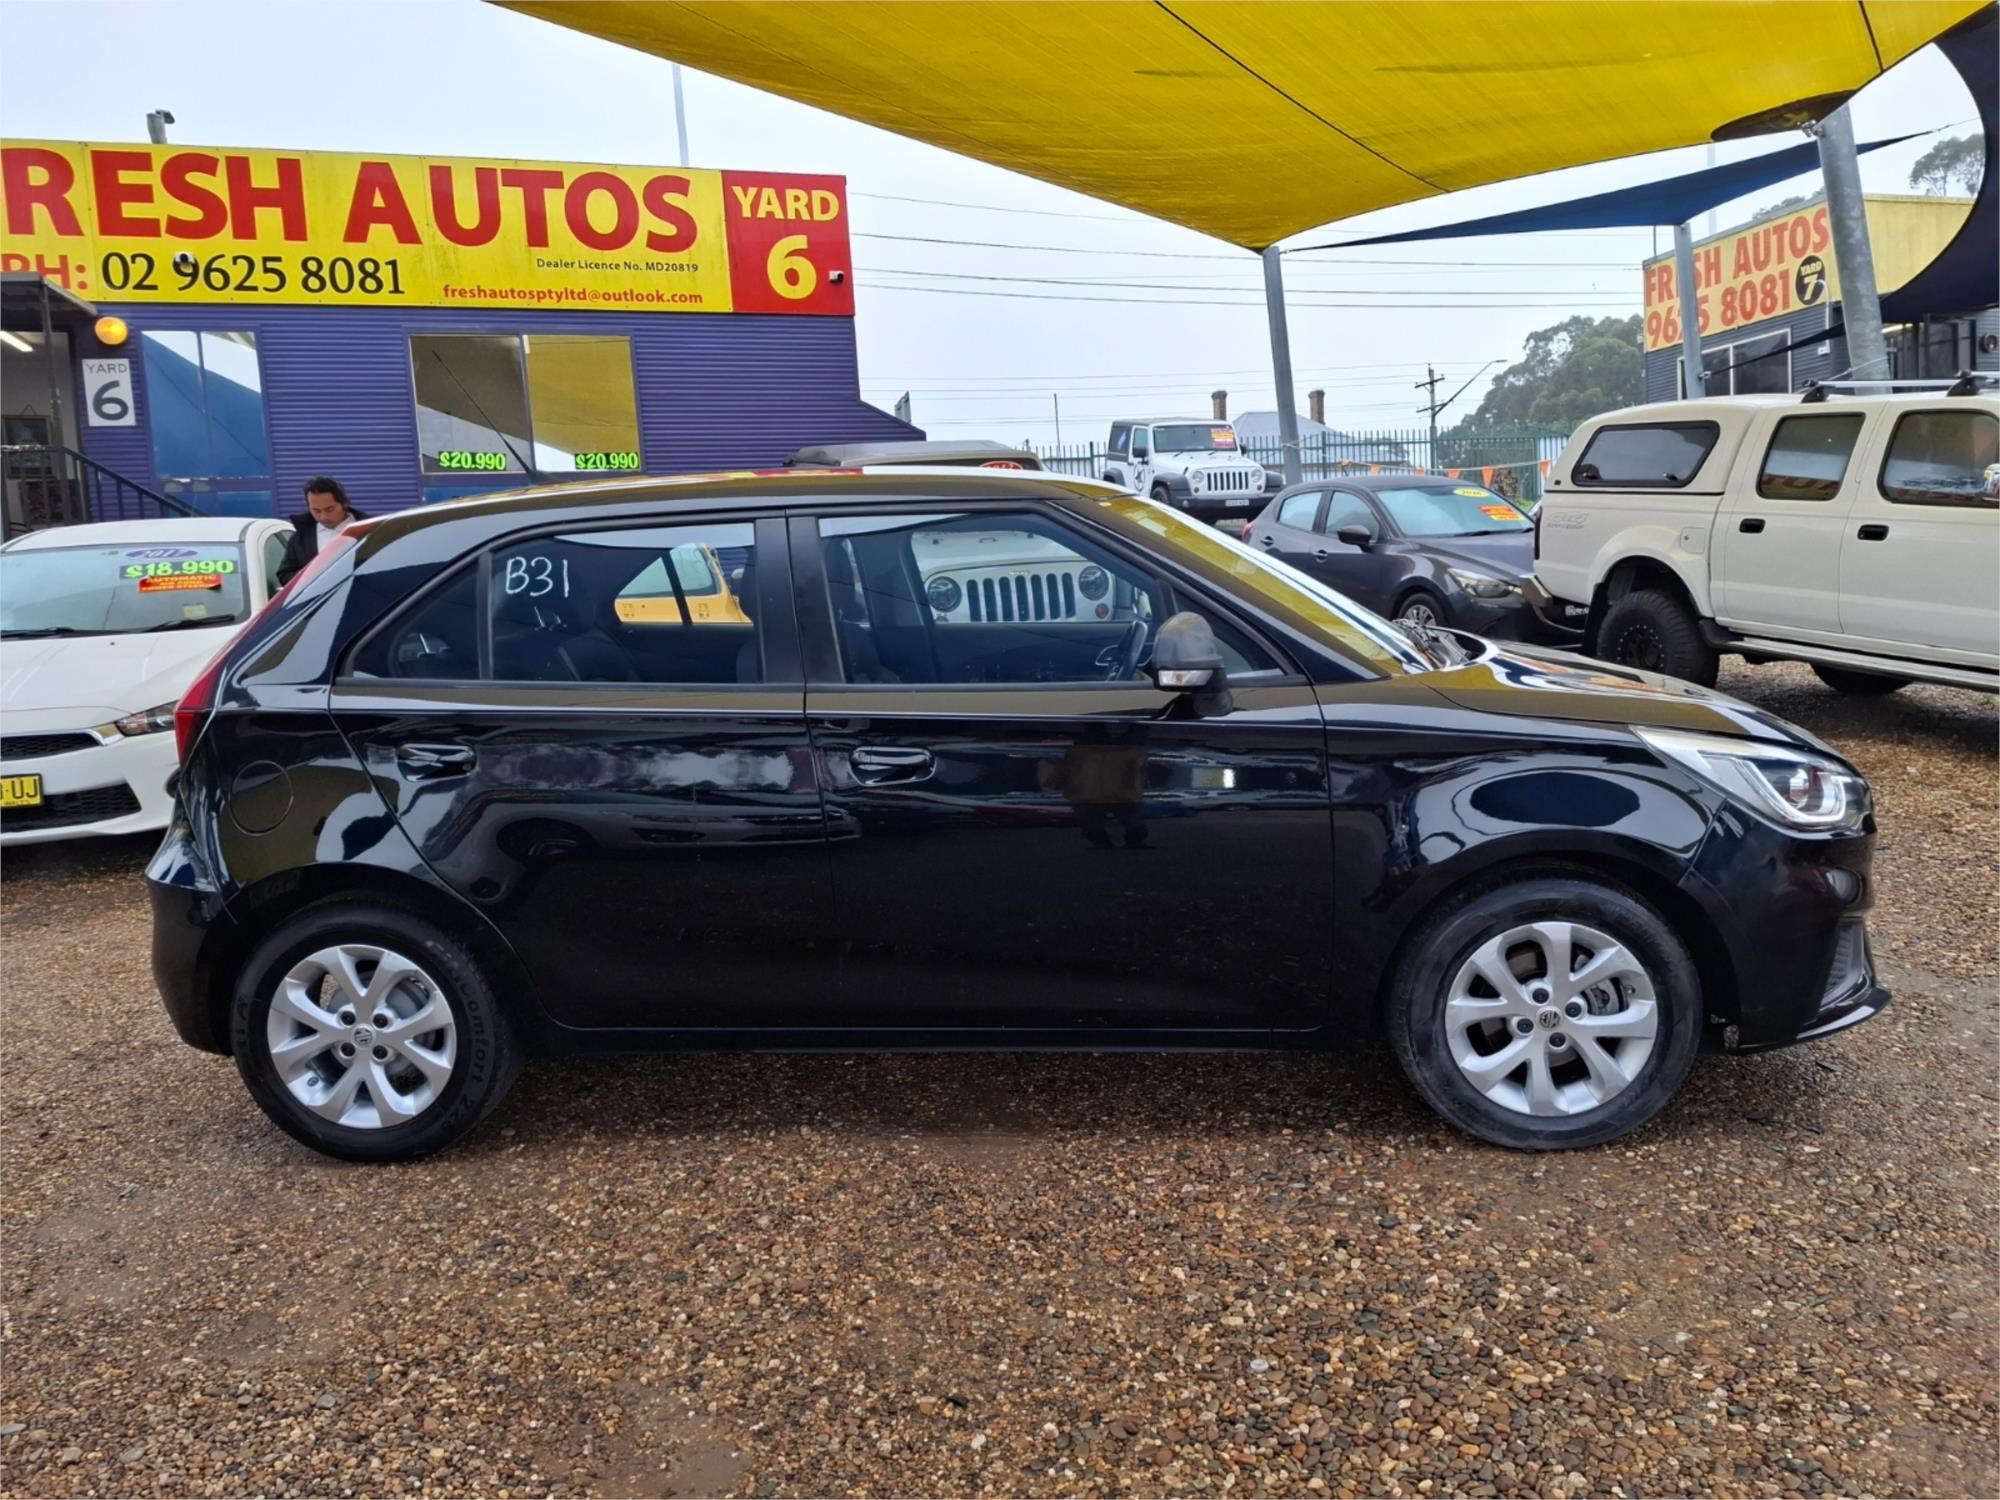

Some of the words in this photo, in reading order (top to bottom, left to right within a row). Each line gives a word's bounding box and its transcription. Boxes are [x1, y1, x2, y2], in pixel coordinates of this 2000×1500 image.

[343, 160, 698, 253] AUTOS
[731, 186, 840, 221] YARD
[102, 252, 159, 291] 02
[173, 253, 287, 293] 9625
[301, 256, 406, 295] 8081
[536, 258, 575, 269] Dealer
[578, 260, 621, 271] Licence
[624, 261, 643, 271] No.
[645, 262, 699, 272] MD20819
[766, 234, 818, 300] 6
[1645, 246, 1722, 307] FRSH
[1732, 207, 1829, 280] AUTOS
[1799, 261, 1822, 276] YARD
[442, 284, 704, 304] freshautosptyltd@outlook.com
[1647, 294, 1710, 348] 965
[1720, 268, 1791, 327] 8081
[86, 363, 128, 374] YARD
[92, 379, 129, 422] 6
[505, 556, 569, 598] B31
